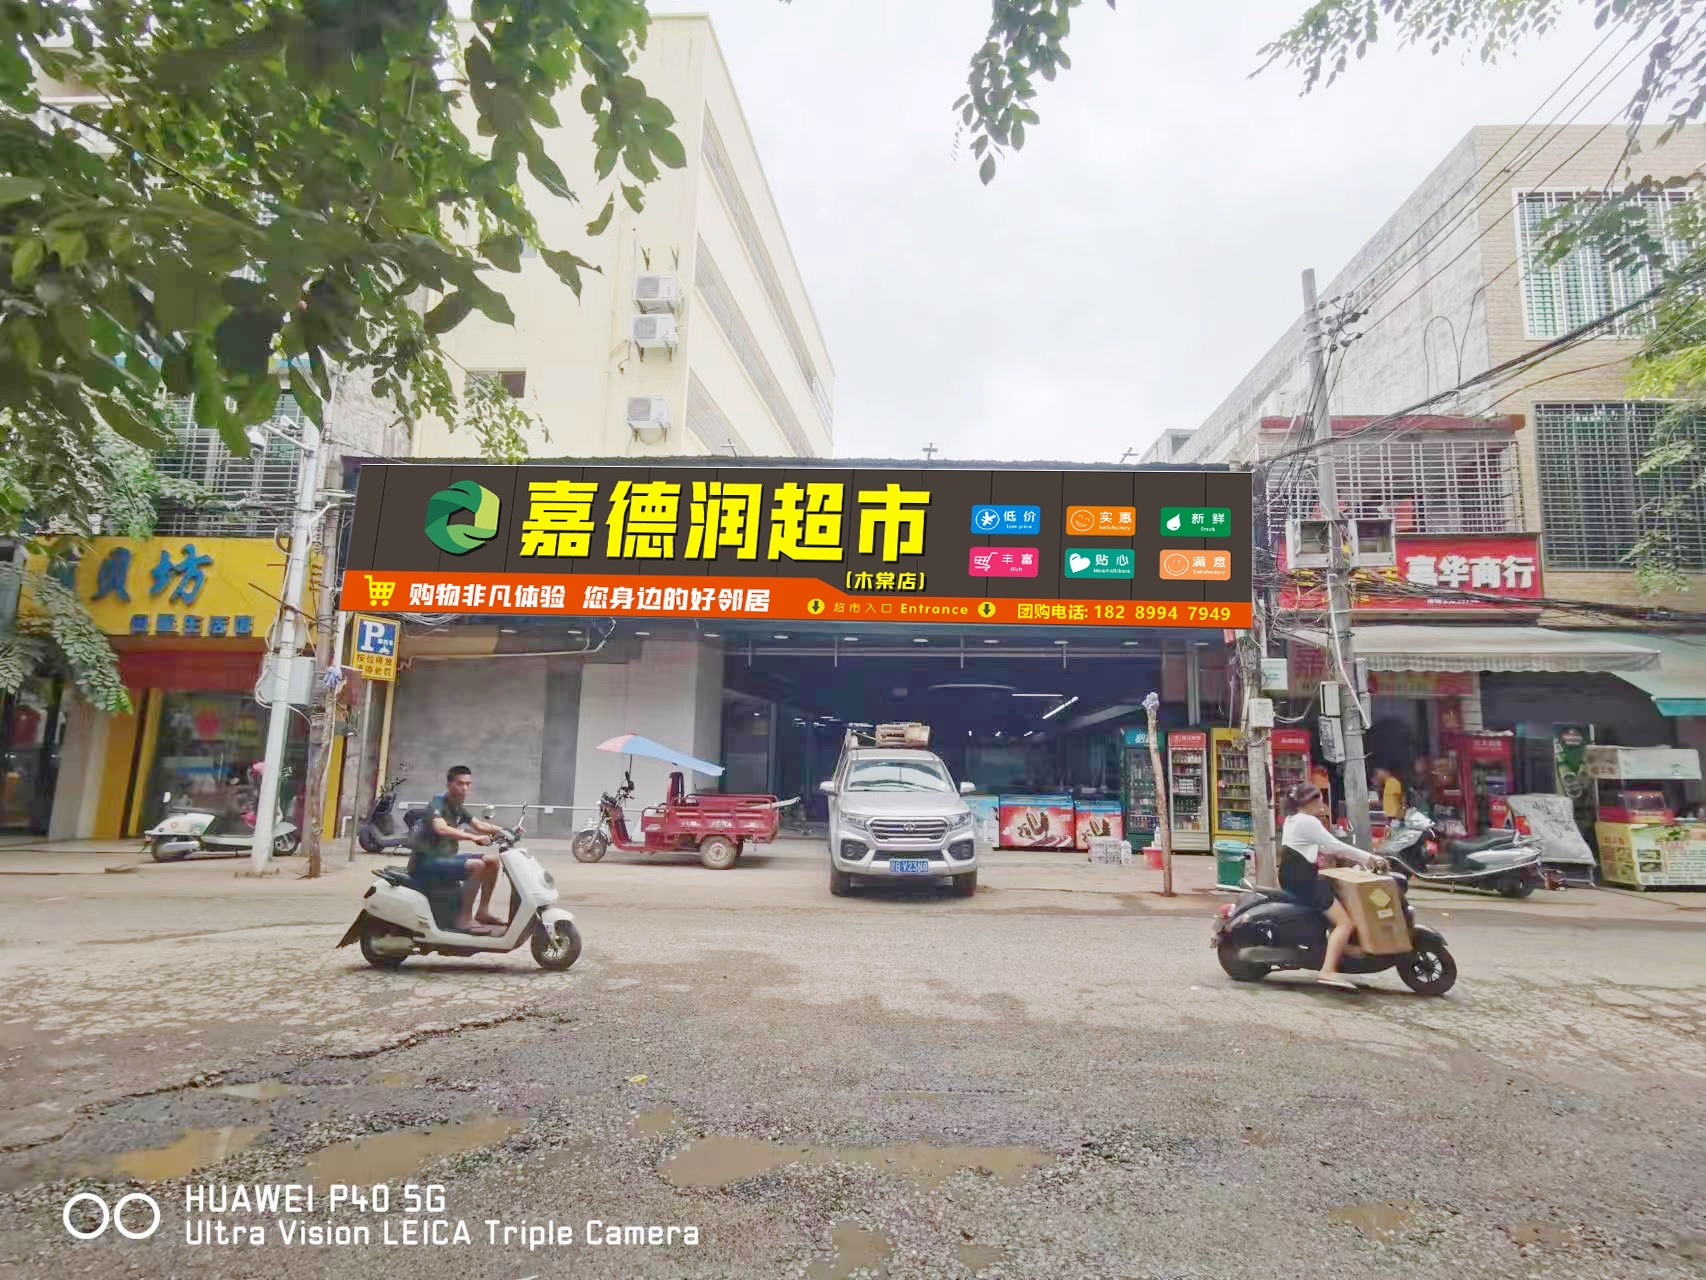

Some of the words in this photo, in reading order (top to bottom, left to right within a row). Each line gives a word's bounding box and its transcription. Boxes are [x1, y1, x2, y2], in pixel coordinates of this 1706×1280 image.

[519, 480, 931, 562] 嘉德润超市
[1003, 510, 1037, 523] 低价
[1099, 511, 1133, 524] 实惠
[1191, 512, 1226, 525] 新鲜
[1001, 553, 1034, 565] 丰富
[1095, 554, 1129, 567] 贴心
[1192, 556, 1227, 568] 满意
[55, 543, 214, 606] 贝坊
[408, 583, 566, 609] 购物非凡体验
[582, 585, 770, 613] 您身边的好邻居
[833, 602, 892, 614] 超市入口
[900, 602, 969, 615] Entrance
[1017, 603, 1089, 621] 团购电话:
[1094, 604, 1125, 619] 182
[1135, 605, 1179, 620] 8994
[1187, 606, 1231, 621] 7949
[360, 620, 385, 651] P
